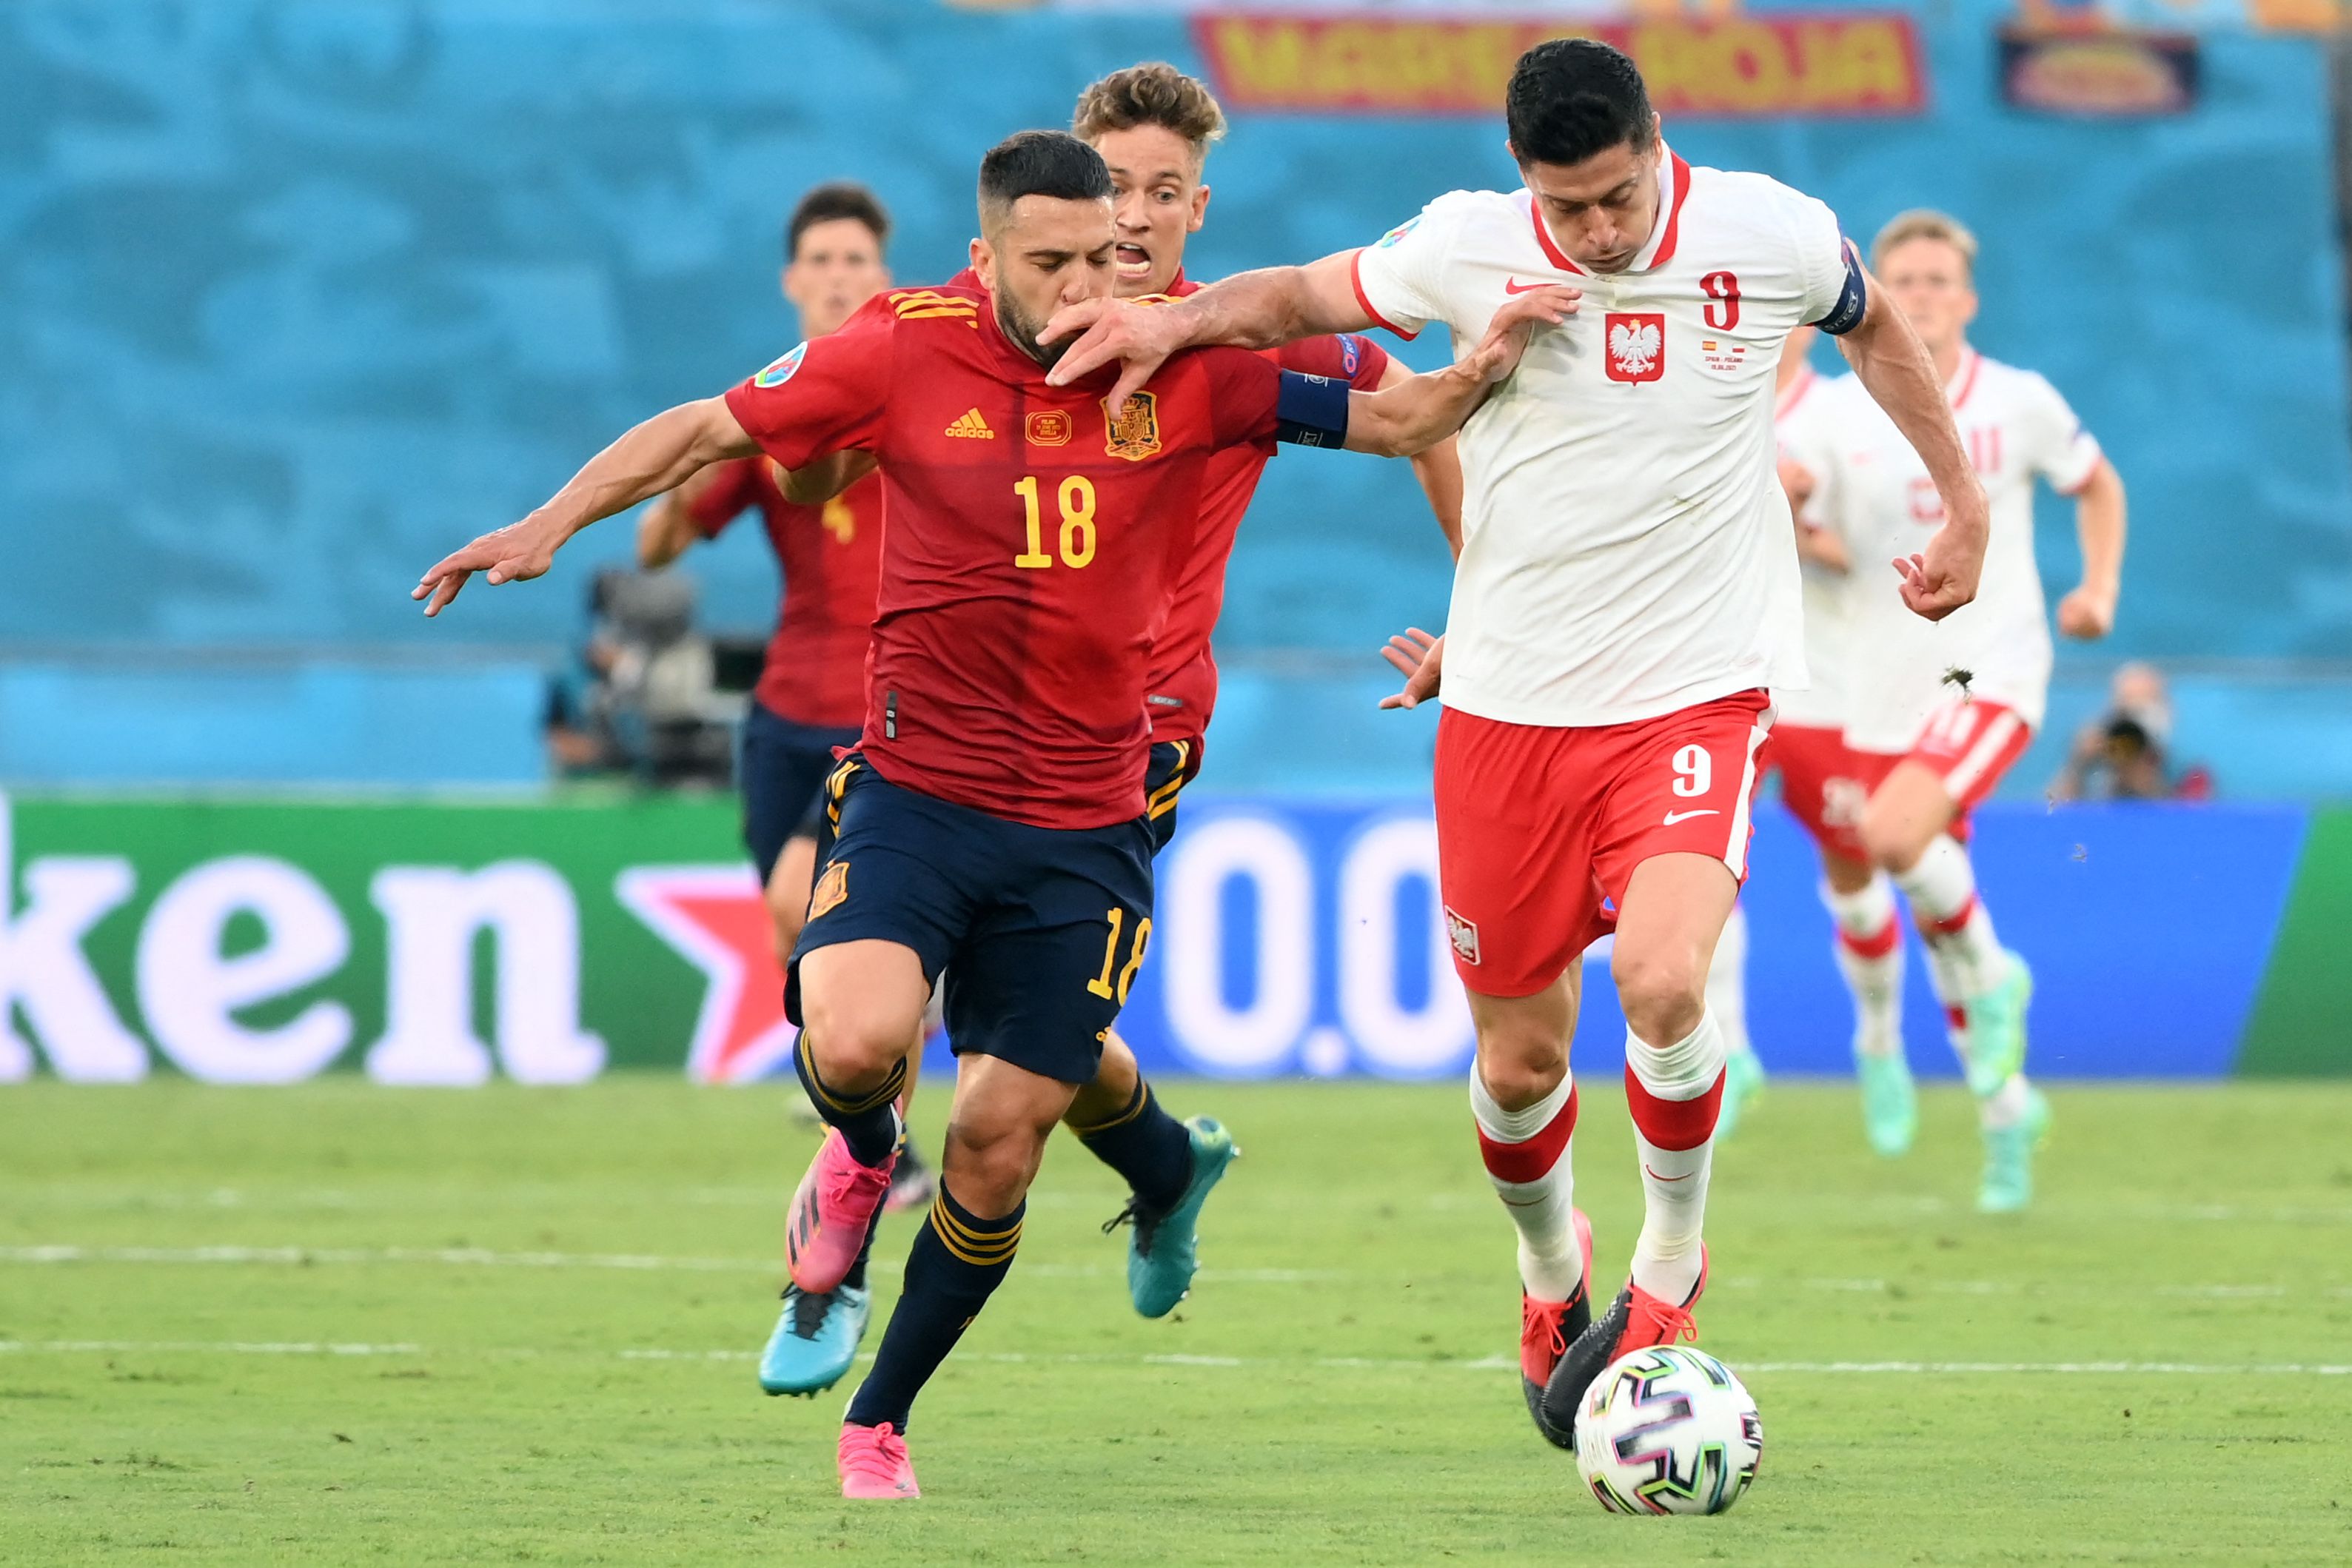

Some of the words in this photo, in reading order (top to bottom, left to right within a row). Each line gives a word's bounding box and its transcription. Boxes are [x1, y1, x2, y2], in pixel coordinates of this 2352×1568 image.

[1700, 271, 1740, 331] 9
[945, 426, 994, 440] adidas
[1013, 475, 1096, 569] 18
[1672, 743, 1712, 797] 9
[1087, 907, 1153, 1008] 18
[1164, 814, 1477, 1076] 0.0
